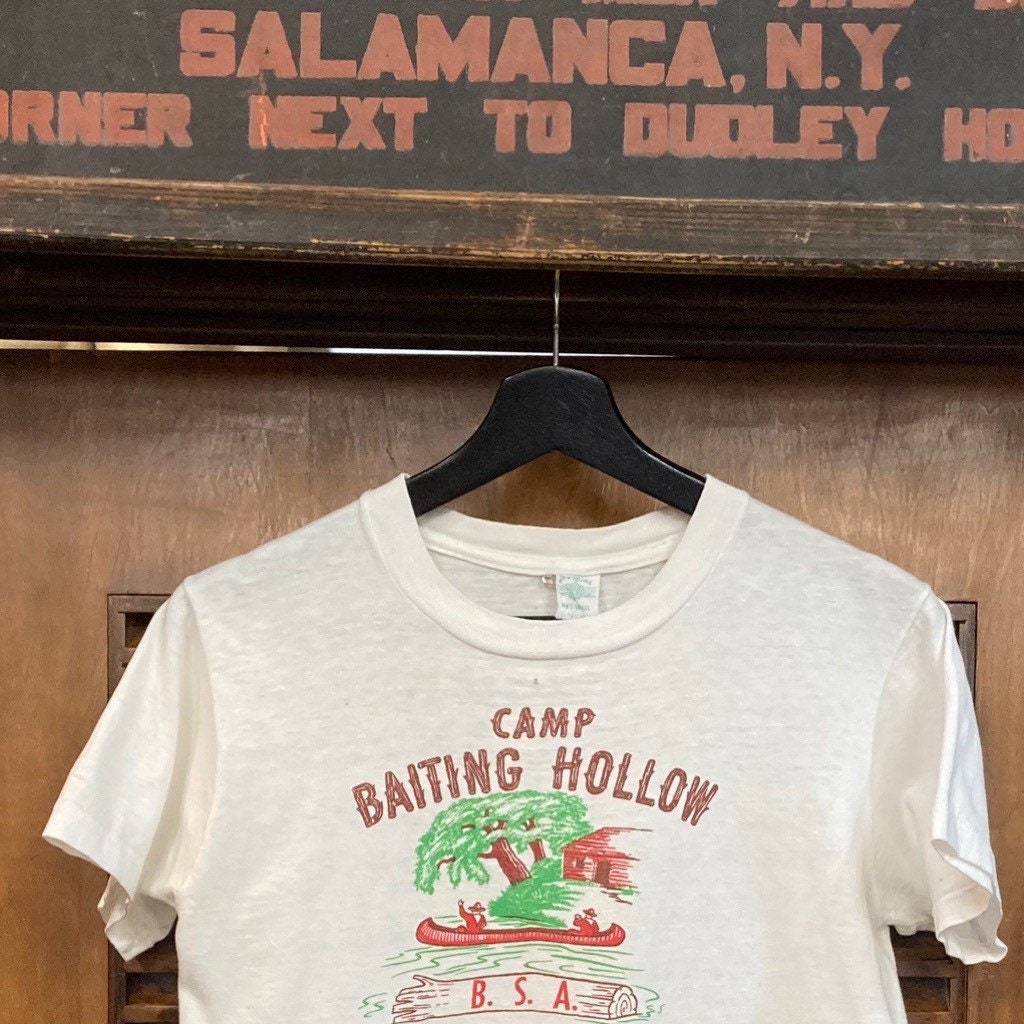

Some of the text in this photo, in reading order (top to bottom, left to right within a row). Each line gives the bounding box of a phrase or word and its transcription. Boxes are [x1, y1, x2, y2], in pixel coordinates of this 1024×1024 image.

[180, 9, 911, 92] SALAMANCA, N.Y.
[0, 89, 193, 147] RNER
[248, 94, 429, 151] NEXT
[483, 98, 573, 154] TO
[623, 102, 890, 161] DUDLEY
[491, 706, 596, 740] CAMP
[351, 745, 719, 828] BAITING HOLLOW
